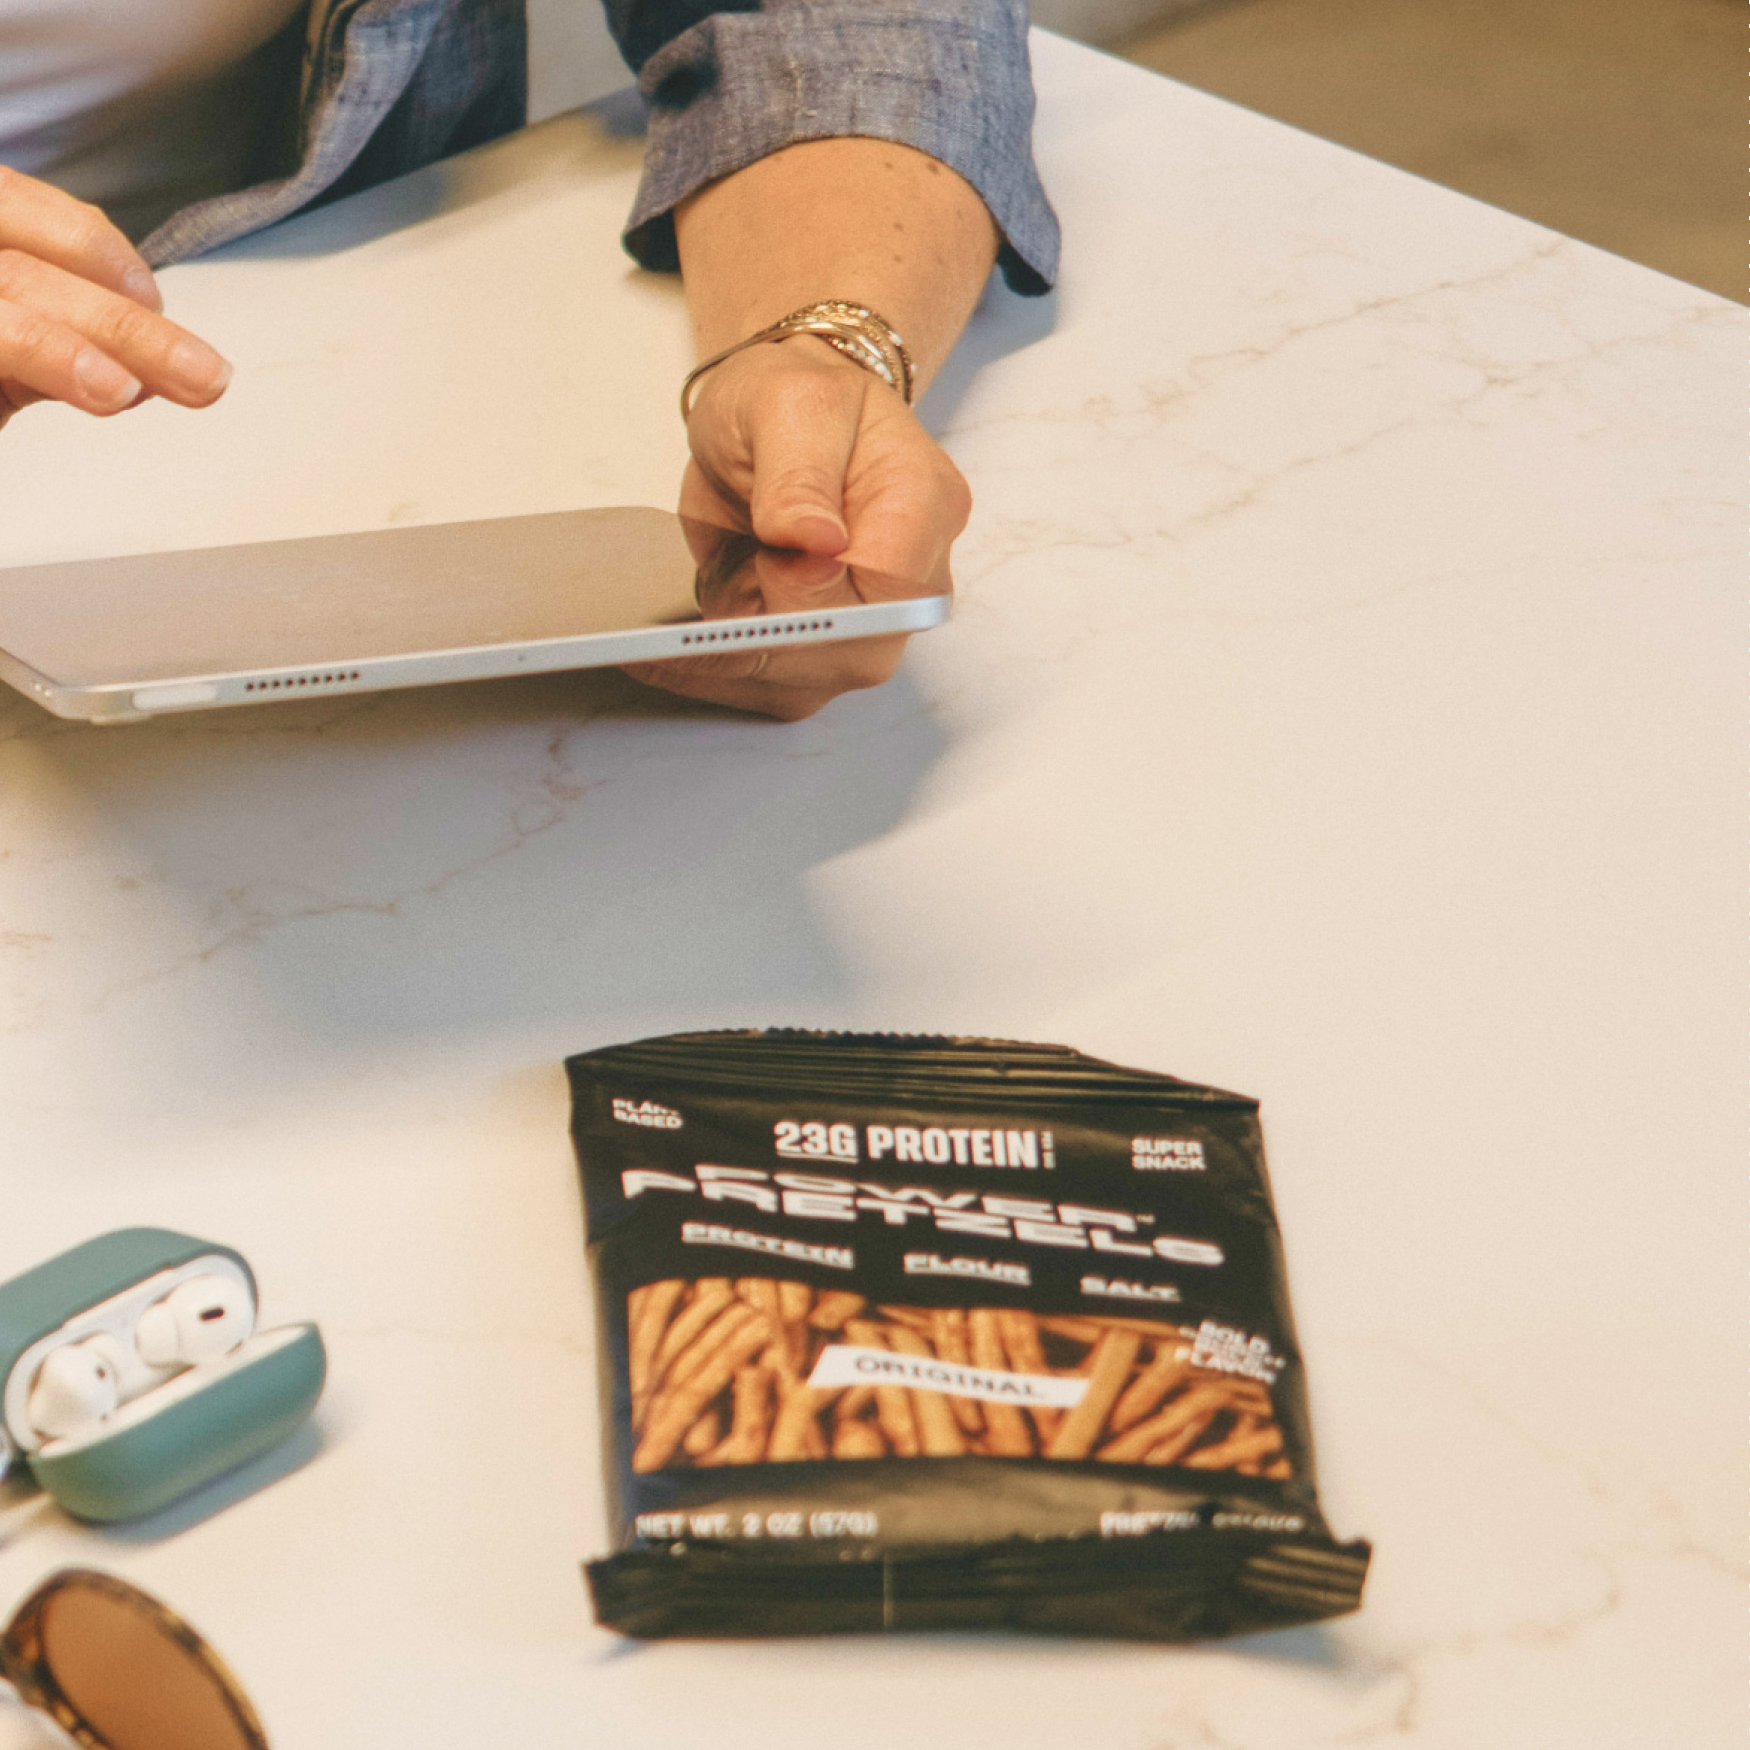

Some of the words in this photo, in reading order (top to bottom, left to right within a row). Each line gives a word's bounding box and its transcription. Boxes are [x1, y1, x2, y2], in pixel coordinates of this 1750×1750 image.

[613, 1109, 683, 1129] BASED
[774, 1120, 857, 1159] 23G
[866, 1124, 1038, 1169] PROTEIN
[1131, 1137, 1203, 1156] SUPER
[1131, 1154, 1207, 1171] SNACK
[621, 1169, 1225, 1265] PRETZELS
[682, 1222, 854, 1268] PROTEIN
[903, 1252, 1030, 1284] FLOUR
[1080, 1275, 1180, 1301] SALT
[855, 1354, 1043, 1399] ORIGINAL
[635, 1512, 684, 1537] NET
